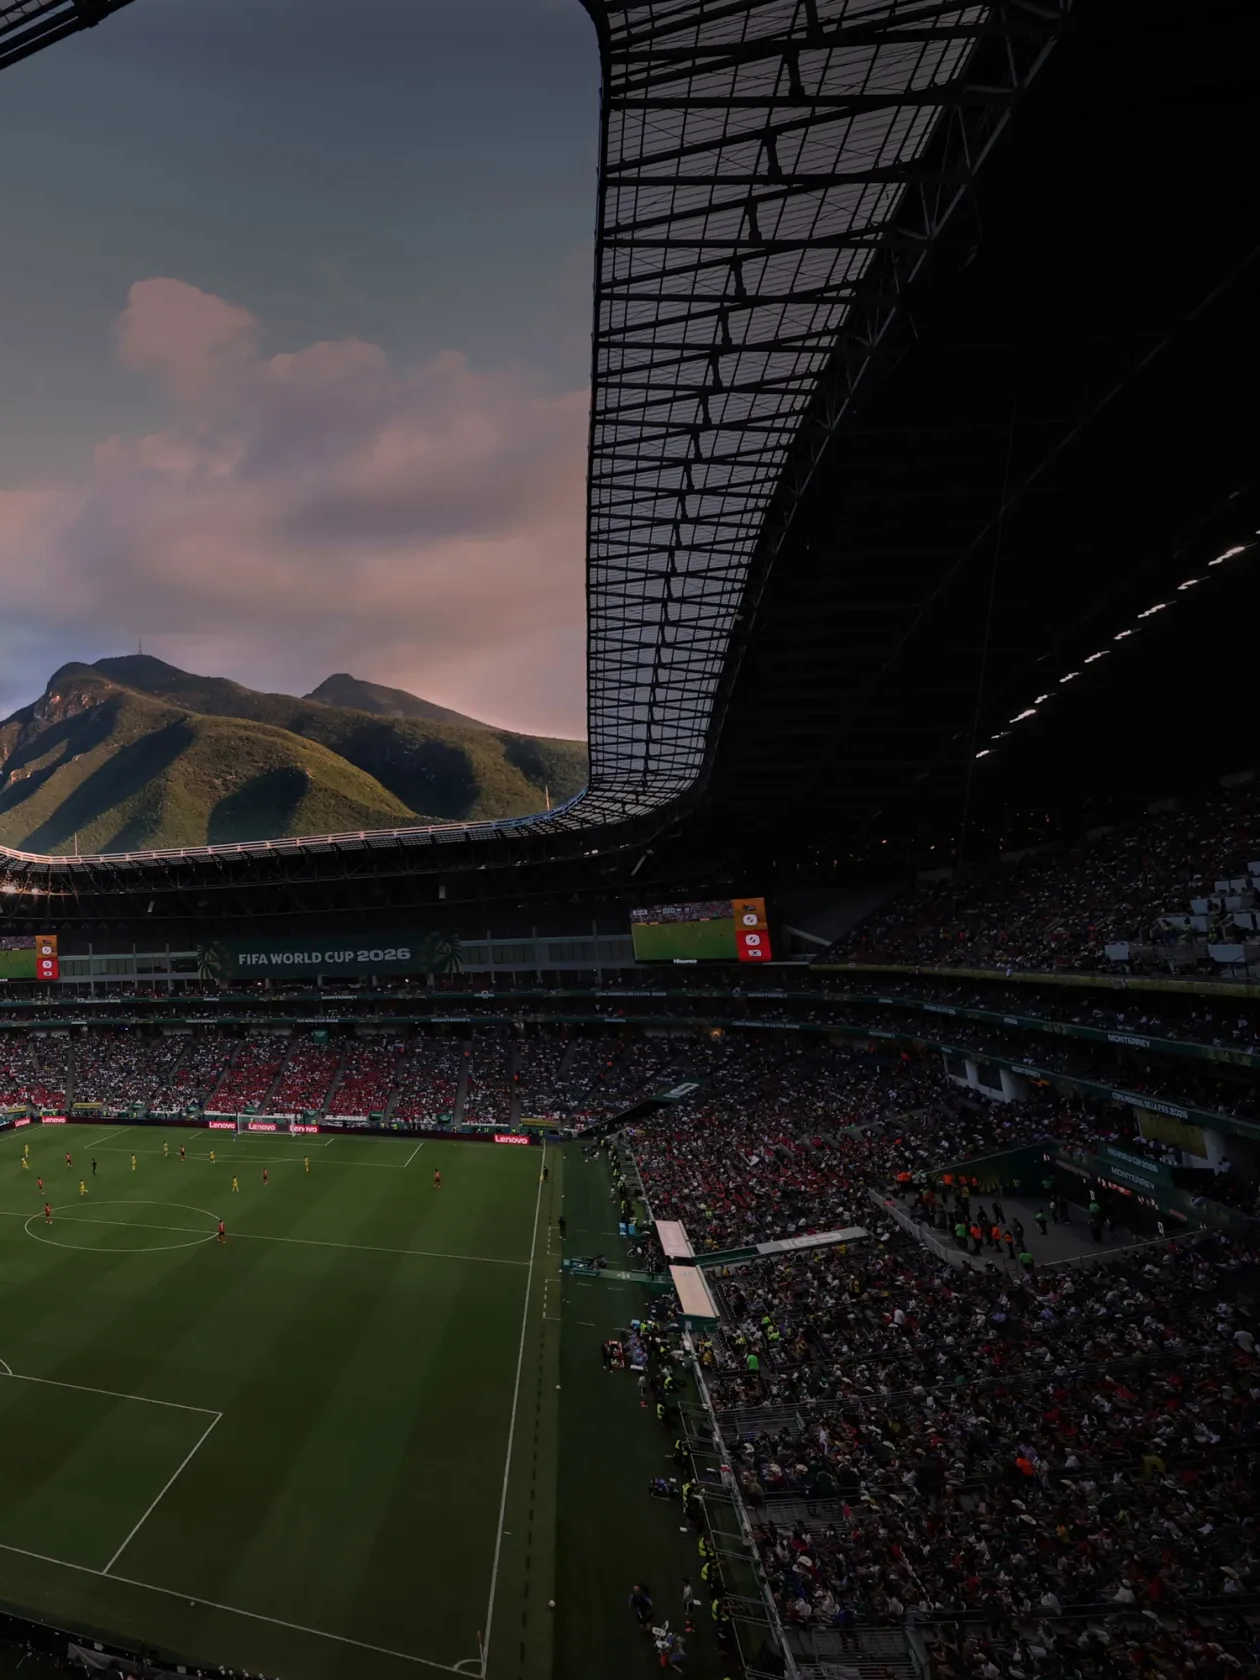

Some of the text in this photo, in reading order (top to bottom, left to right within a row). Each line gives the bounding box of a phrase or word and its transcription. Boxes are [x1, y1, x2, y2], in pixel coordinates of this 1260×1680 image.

[238, 948, 411, 965] FIFA WORLD CUP 2026
[209, 1121, 235, 1129] Lenovo
[248, 1123, 276, 1131] Lenovo
[494, 1134, 528, 1144] Lenovo
